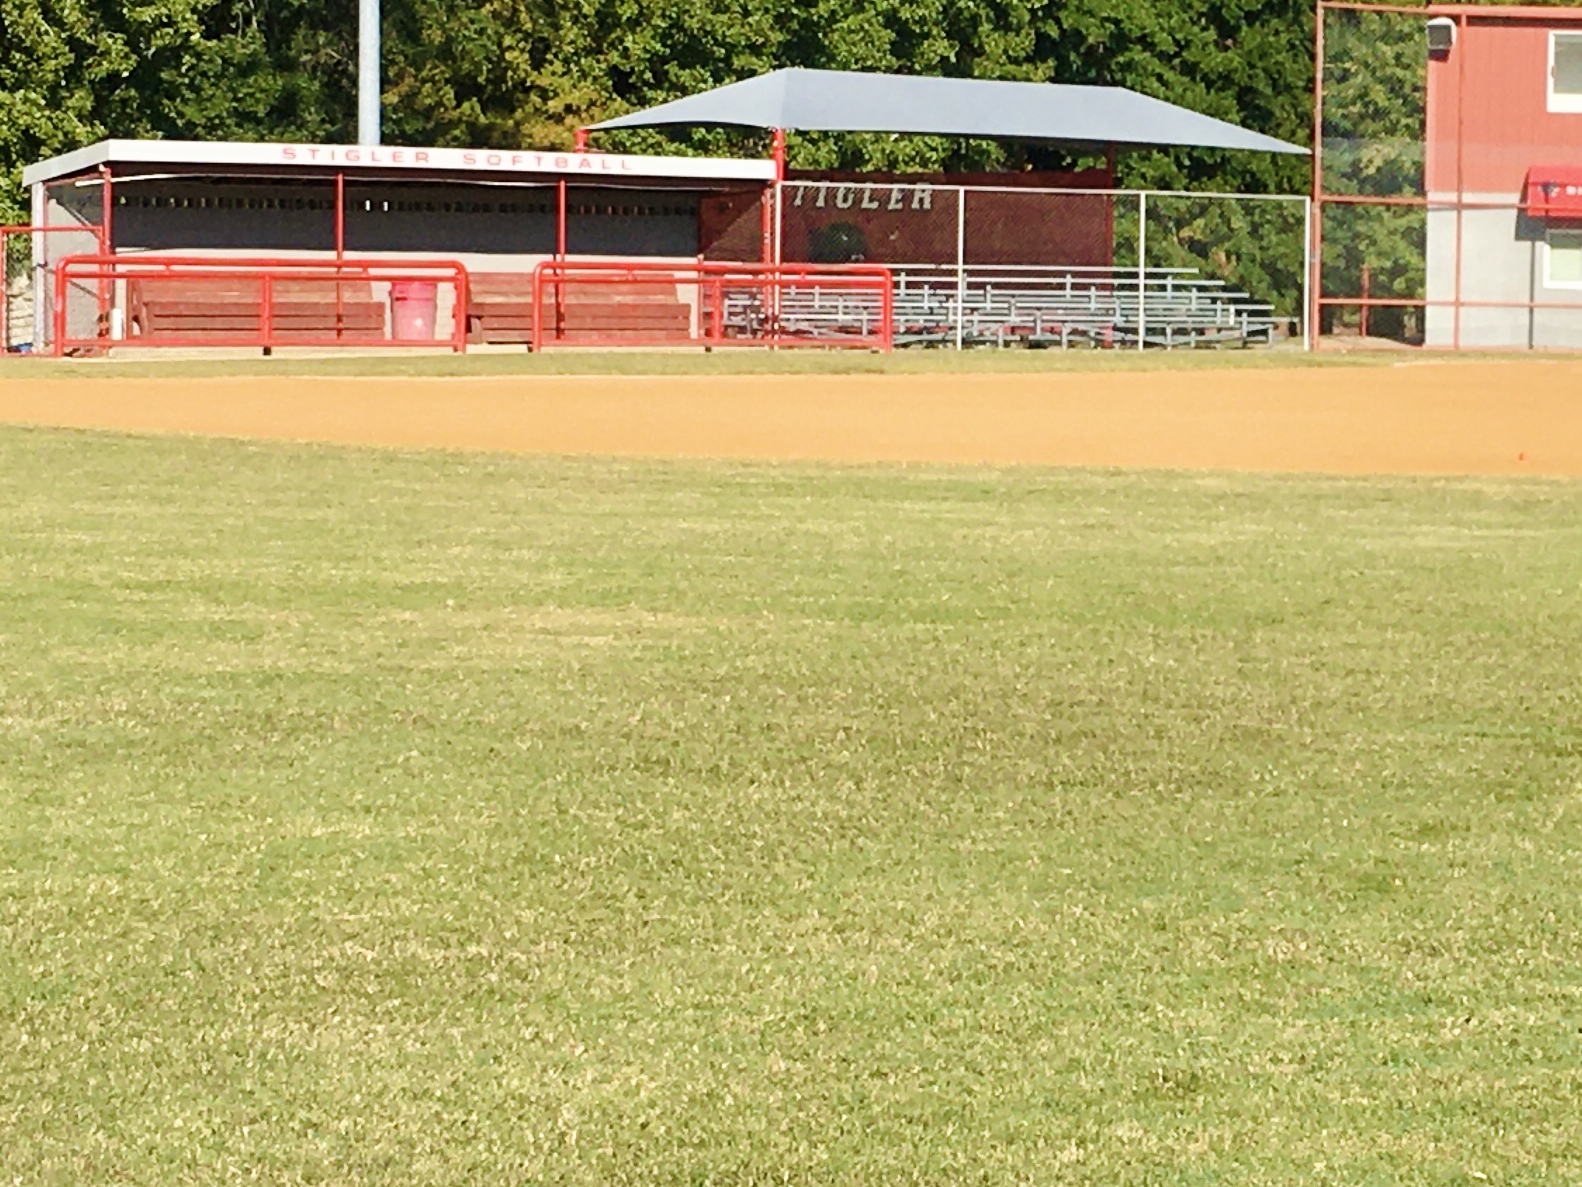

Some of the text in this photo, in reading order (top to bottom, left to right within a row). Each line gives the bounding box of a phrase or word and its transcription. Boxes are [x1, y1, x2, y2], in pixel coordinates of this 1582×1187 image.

[282, 146, 632, 172] STIGLER SOFTBALL
[793, 180, 933, 210] TIGLER
